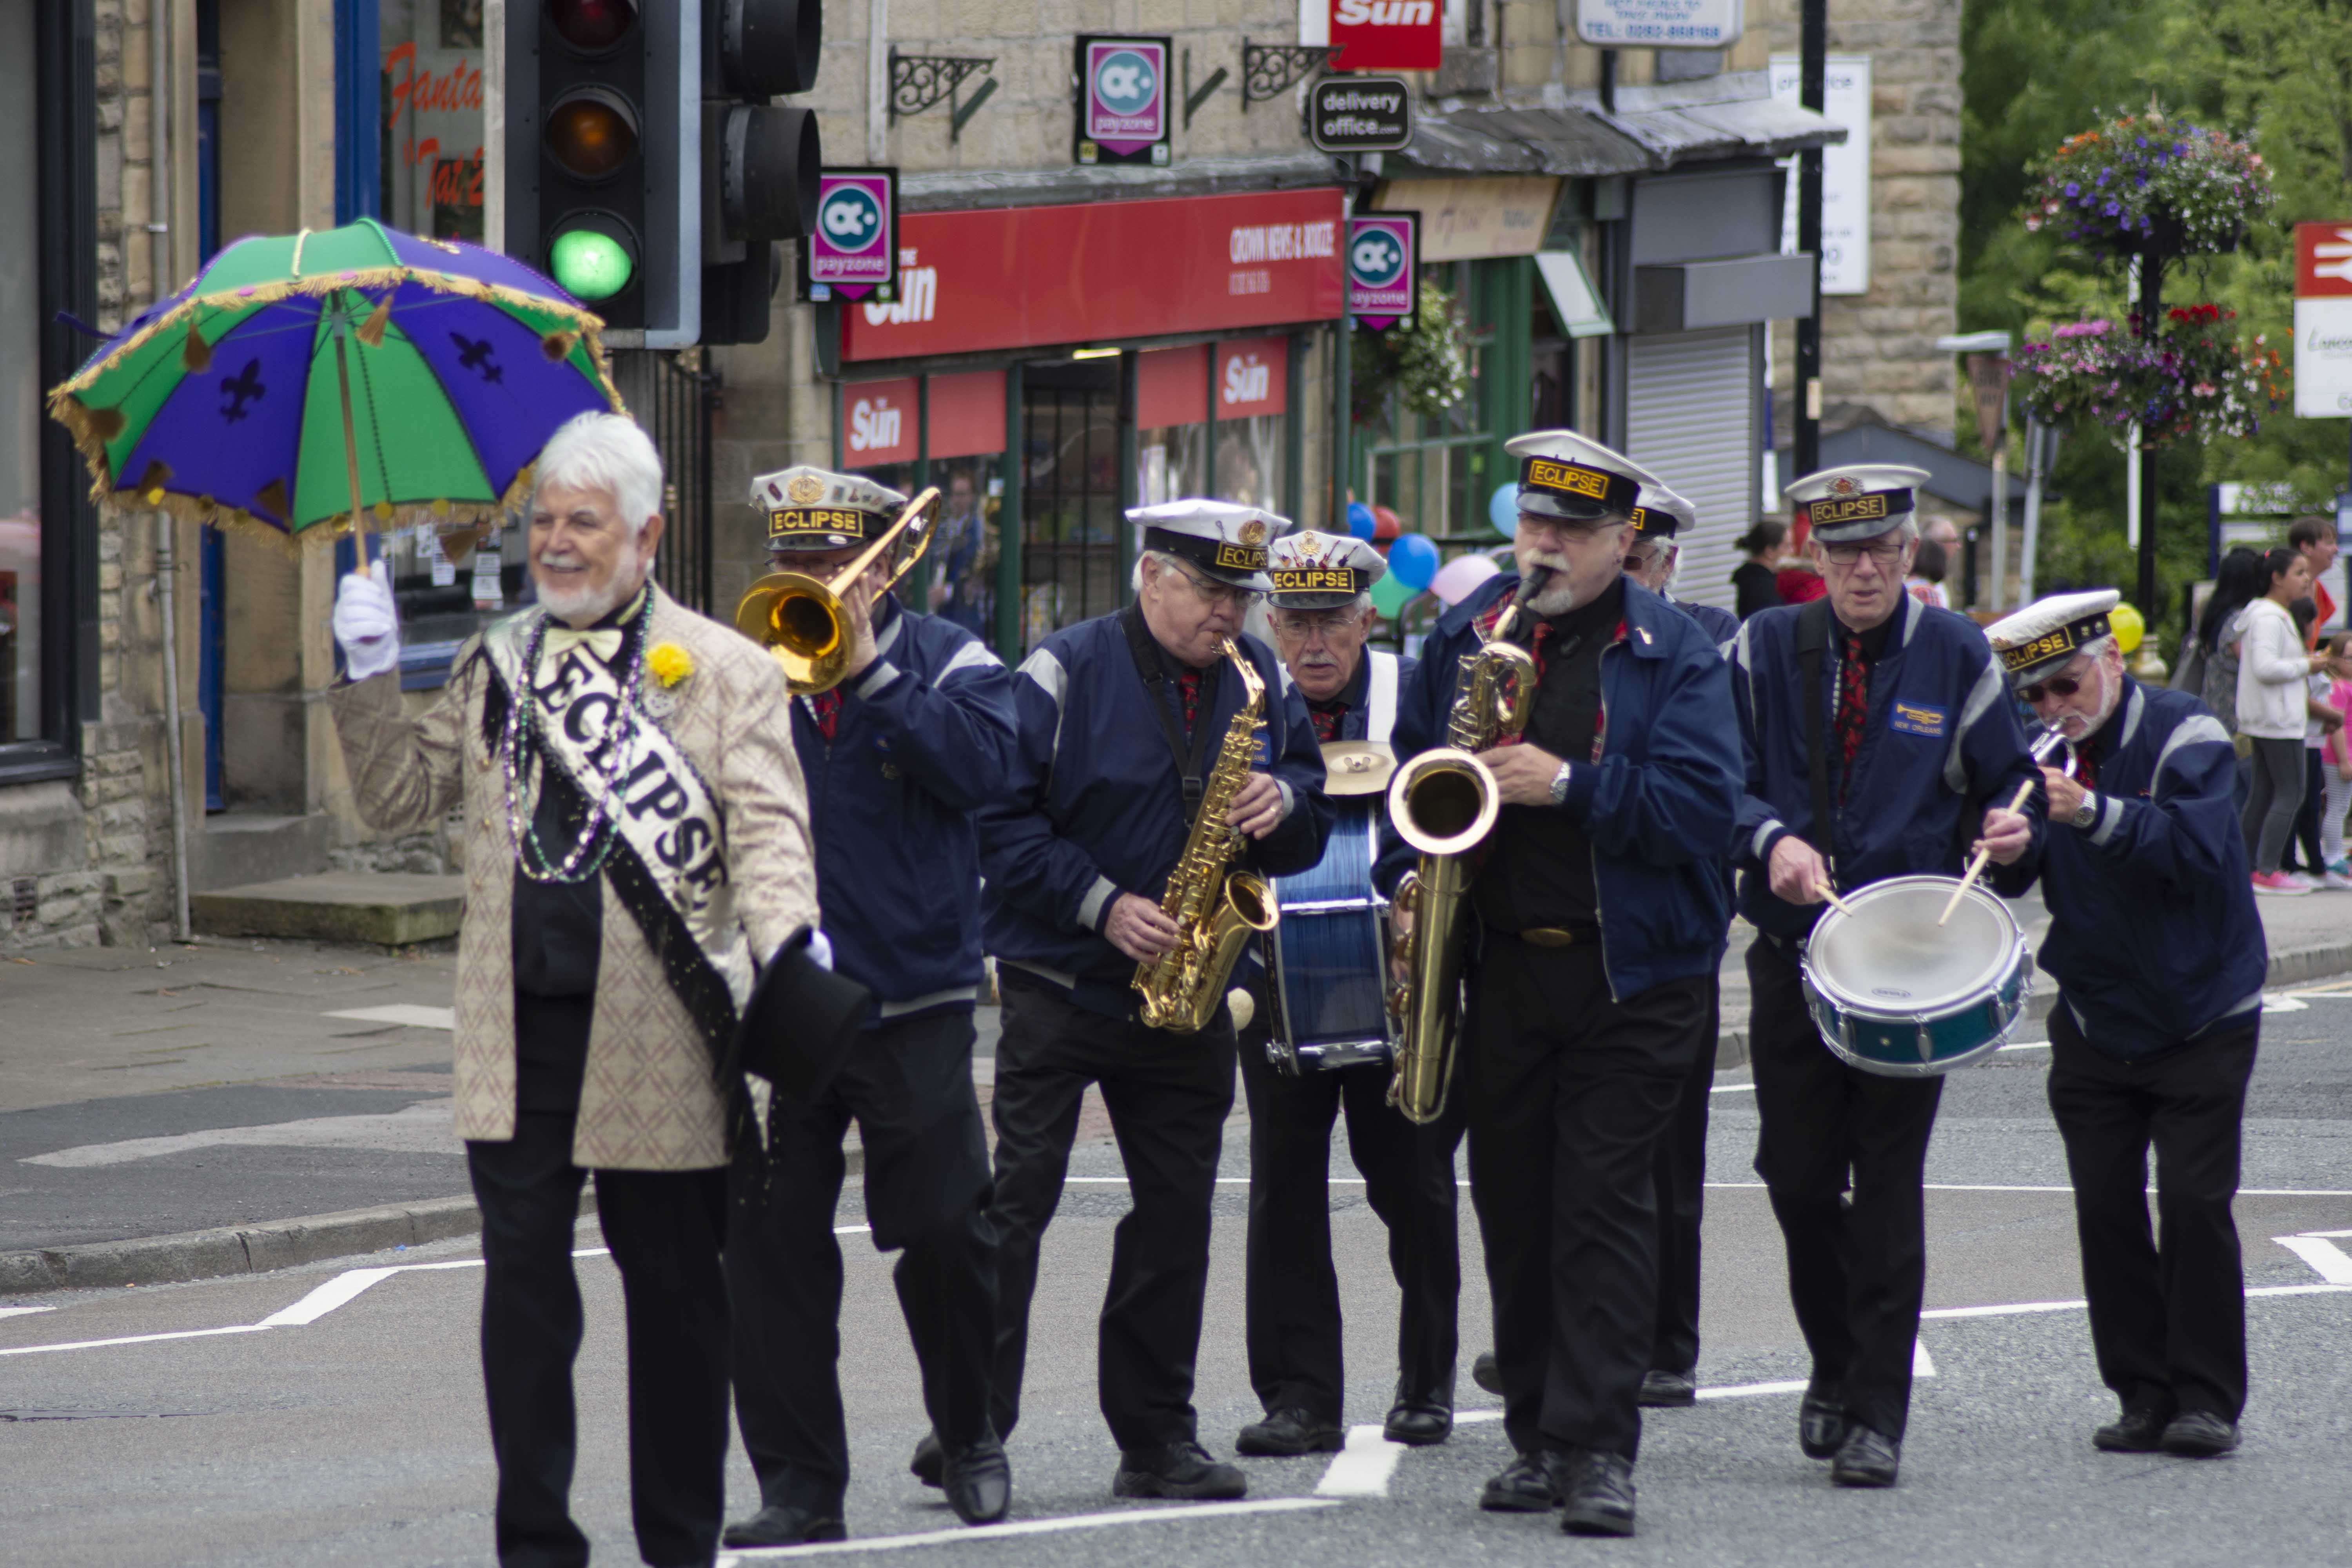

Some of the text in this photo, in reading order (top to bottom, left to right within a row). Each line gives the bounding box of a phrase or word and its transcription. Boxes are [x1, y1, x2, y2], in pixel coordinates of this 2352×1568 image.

[1334, 0, 1435, 25] Sun
[1323, 91, 1401, 114] delivery
[1095, 118, 1155, 135] payzone
[816, 256, 884, 275] payzone
[864, 265, 936, 326] un
[1222, 354, 1269, 404] Sun
[849, 398, 901, 451] Sun
[1534, 465, 1602, 494] ECLIPSE
[775, 511, 856, 530] ECLIPSE
[1815, 499, 1880, 521] ECLIPSE
[1274, 572, 1348, 588] ECLIPSE
[1895, 720, 1942, 735] NEW ORLEANS
[533, 652, 728, 911] ECLIPSE
